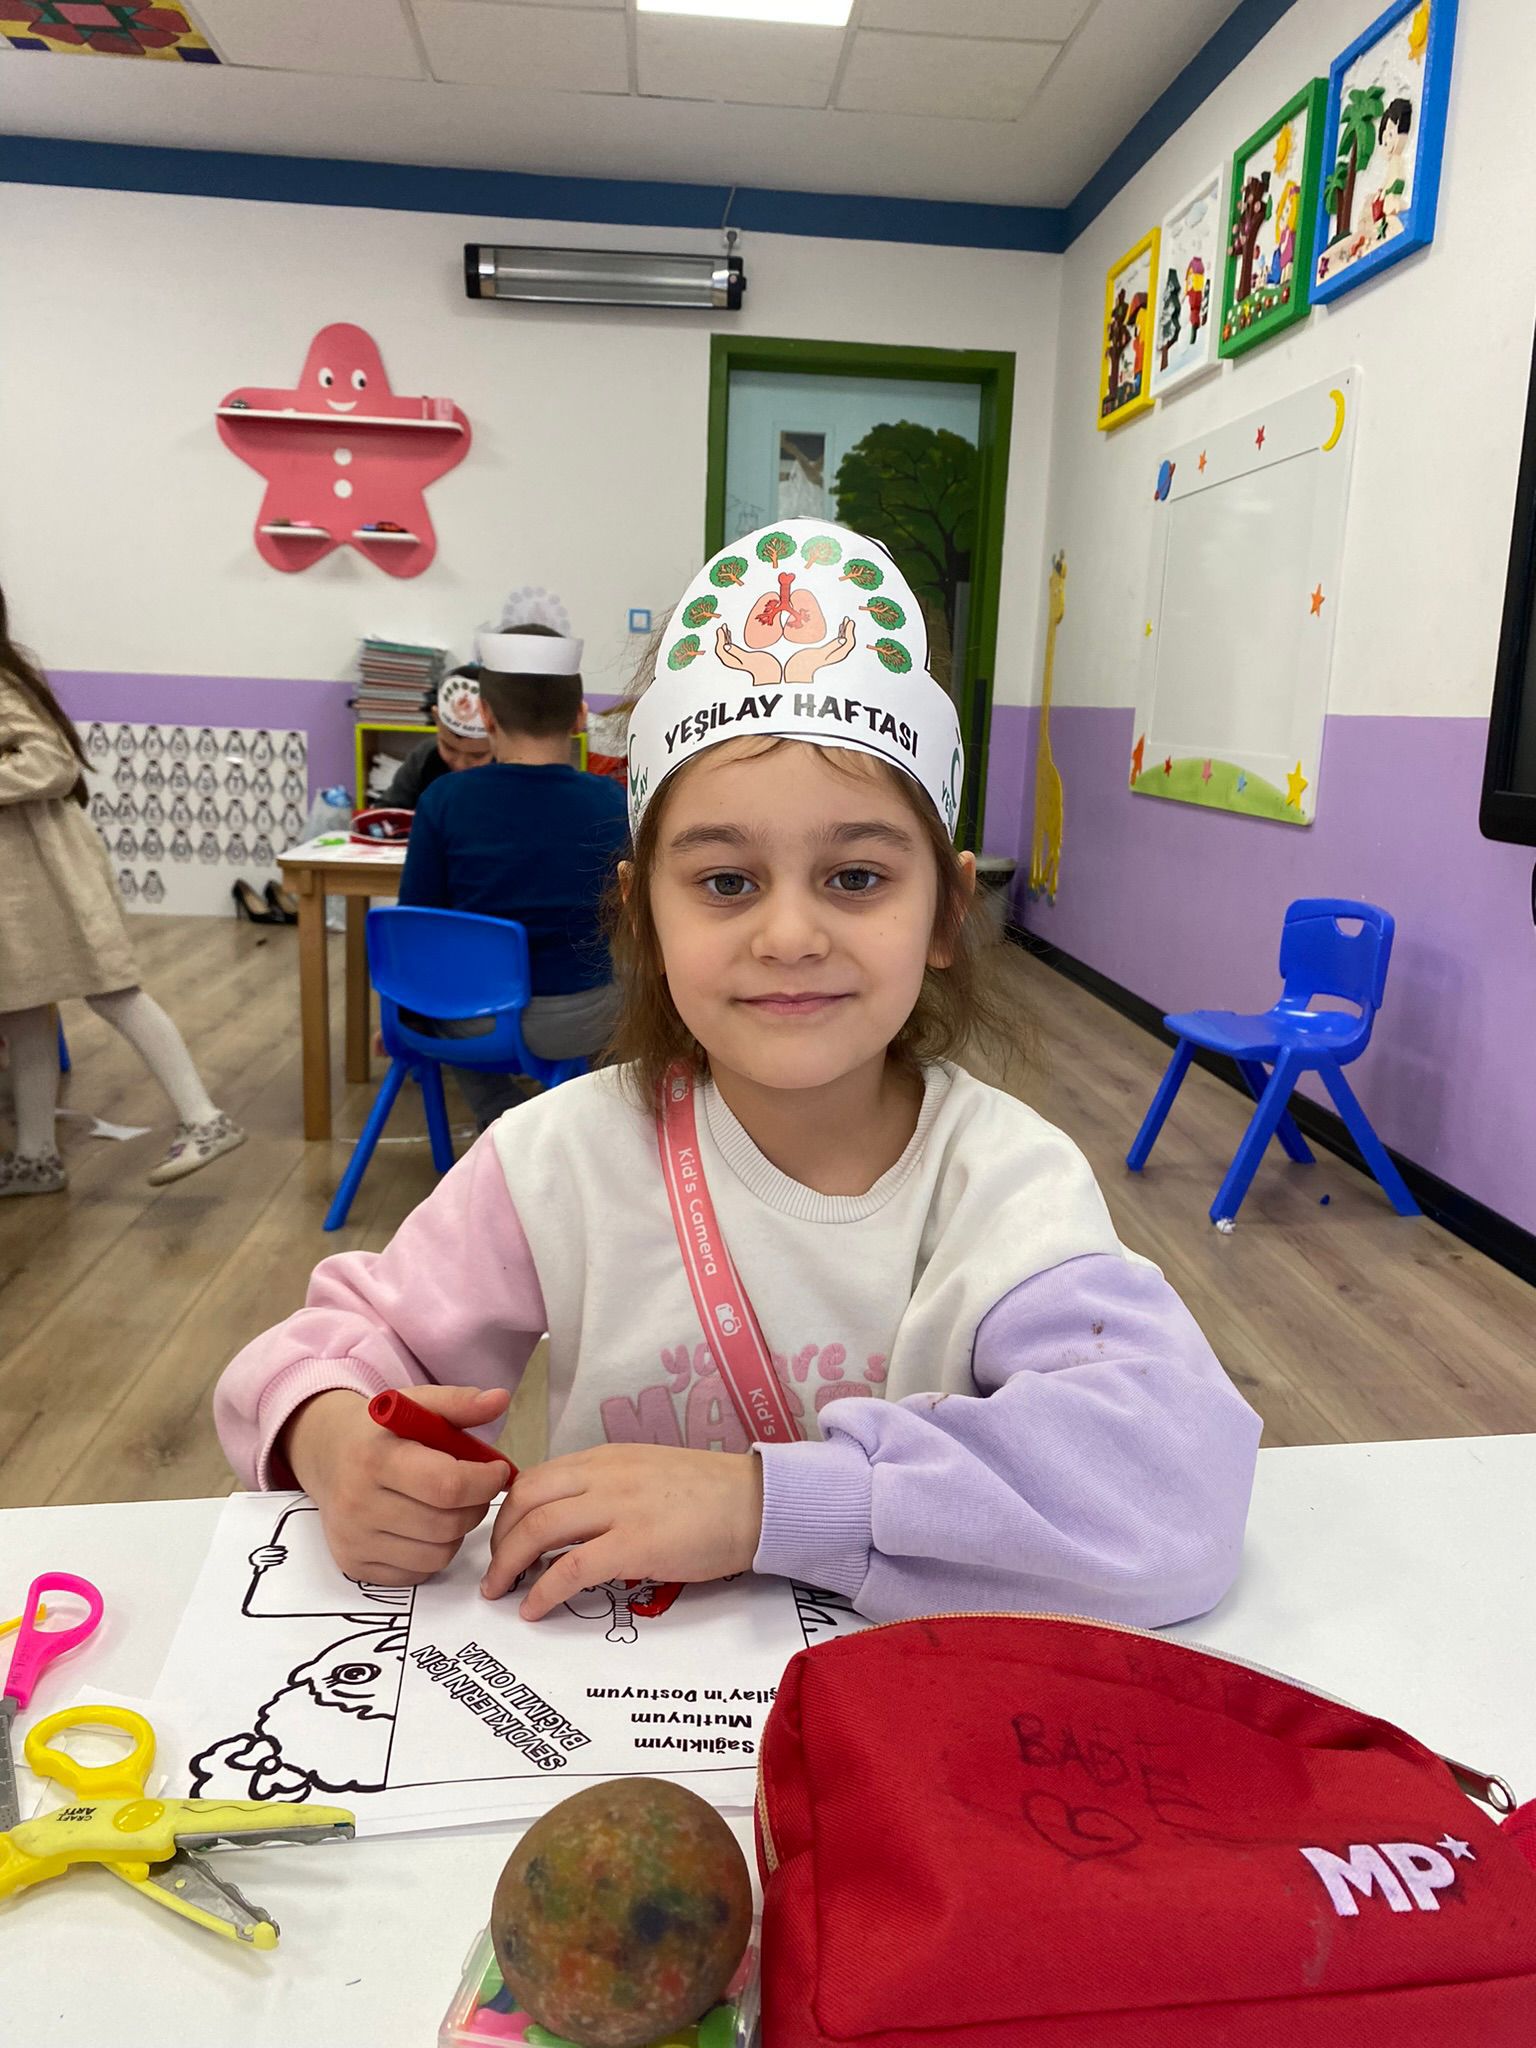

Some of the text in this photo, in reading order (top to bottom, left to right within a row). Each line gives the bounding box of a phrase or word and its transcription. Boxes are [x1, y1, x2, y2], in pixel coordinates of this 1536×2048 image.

[664, 693, 919, 758] YEŞİLAY HAFTASI
[678, 1147, 718, 1276] Kid's Camera
[659, 1343, 720, 1393] yo
[738, 1387, 776, 1437] Kid's
[409, 1644, 567, 1770] SEVDİKLERİN İÇİN
[455, 1641, 592, 1751] BAĞIMLI OLMA
[586, 1686, 778, 1704] şilay'ın Dostuyum
[630, 1711, 752, 1728] Mutluyum
[634, 1736, 755, 1755] Sağlıklıyım
[1299, 1842, 1456, 1916] MP
